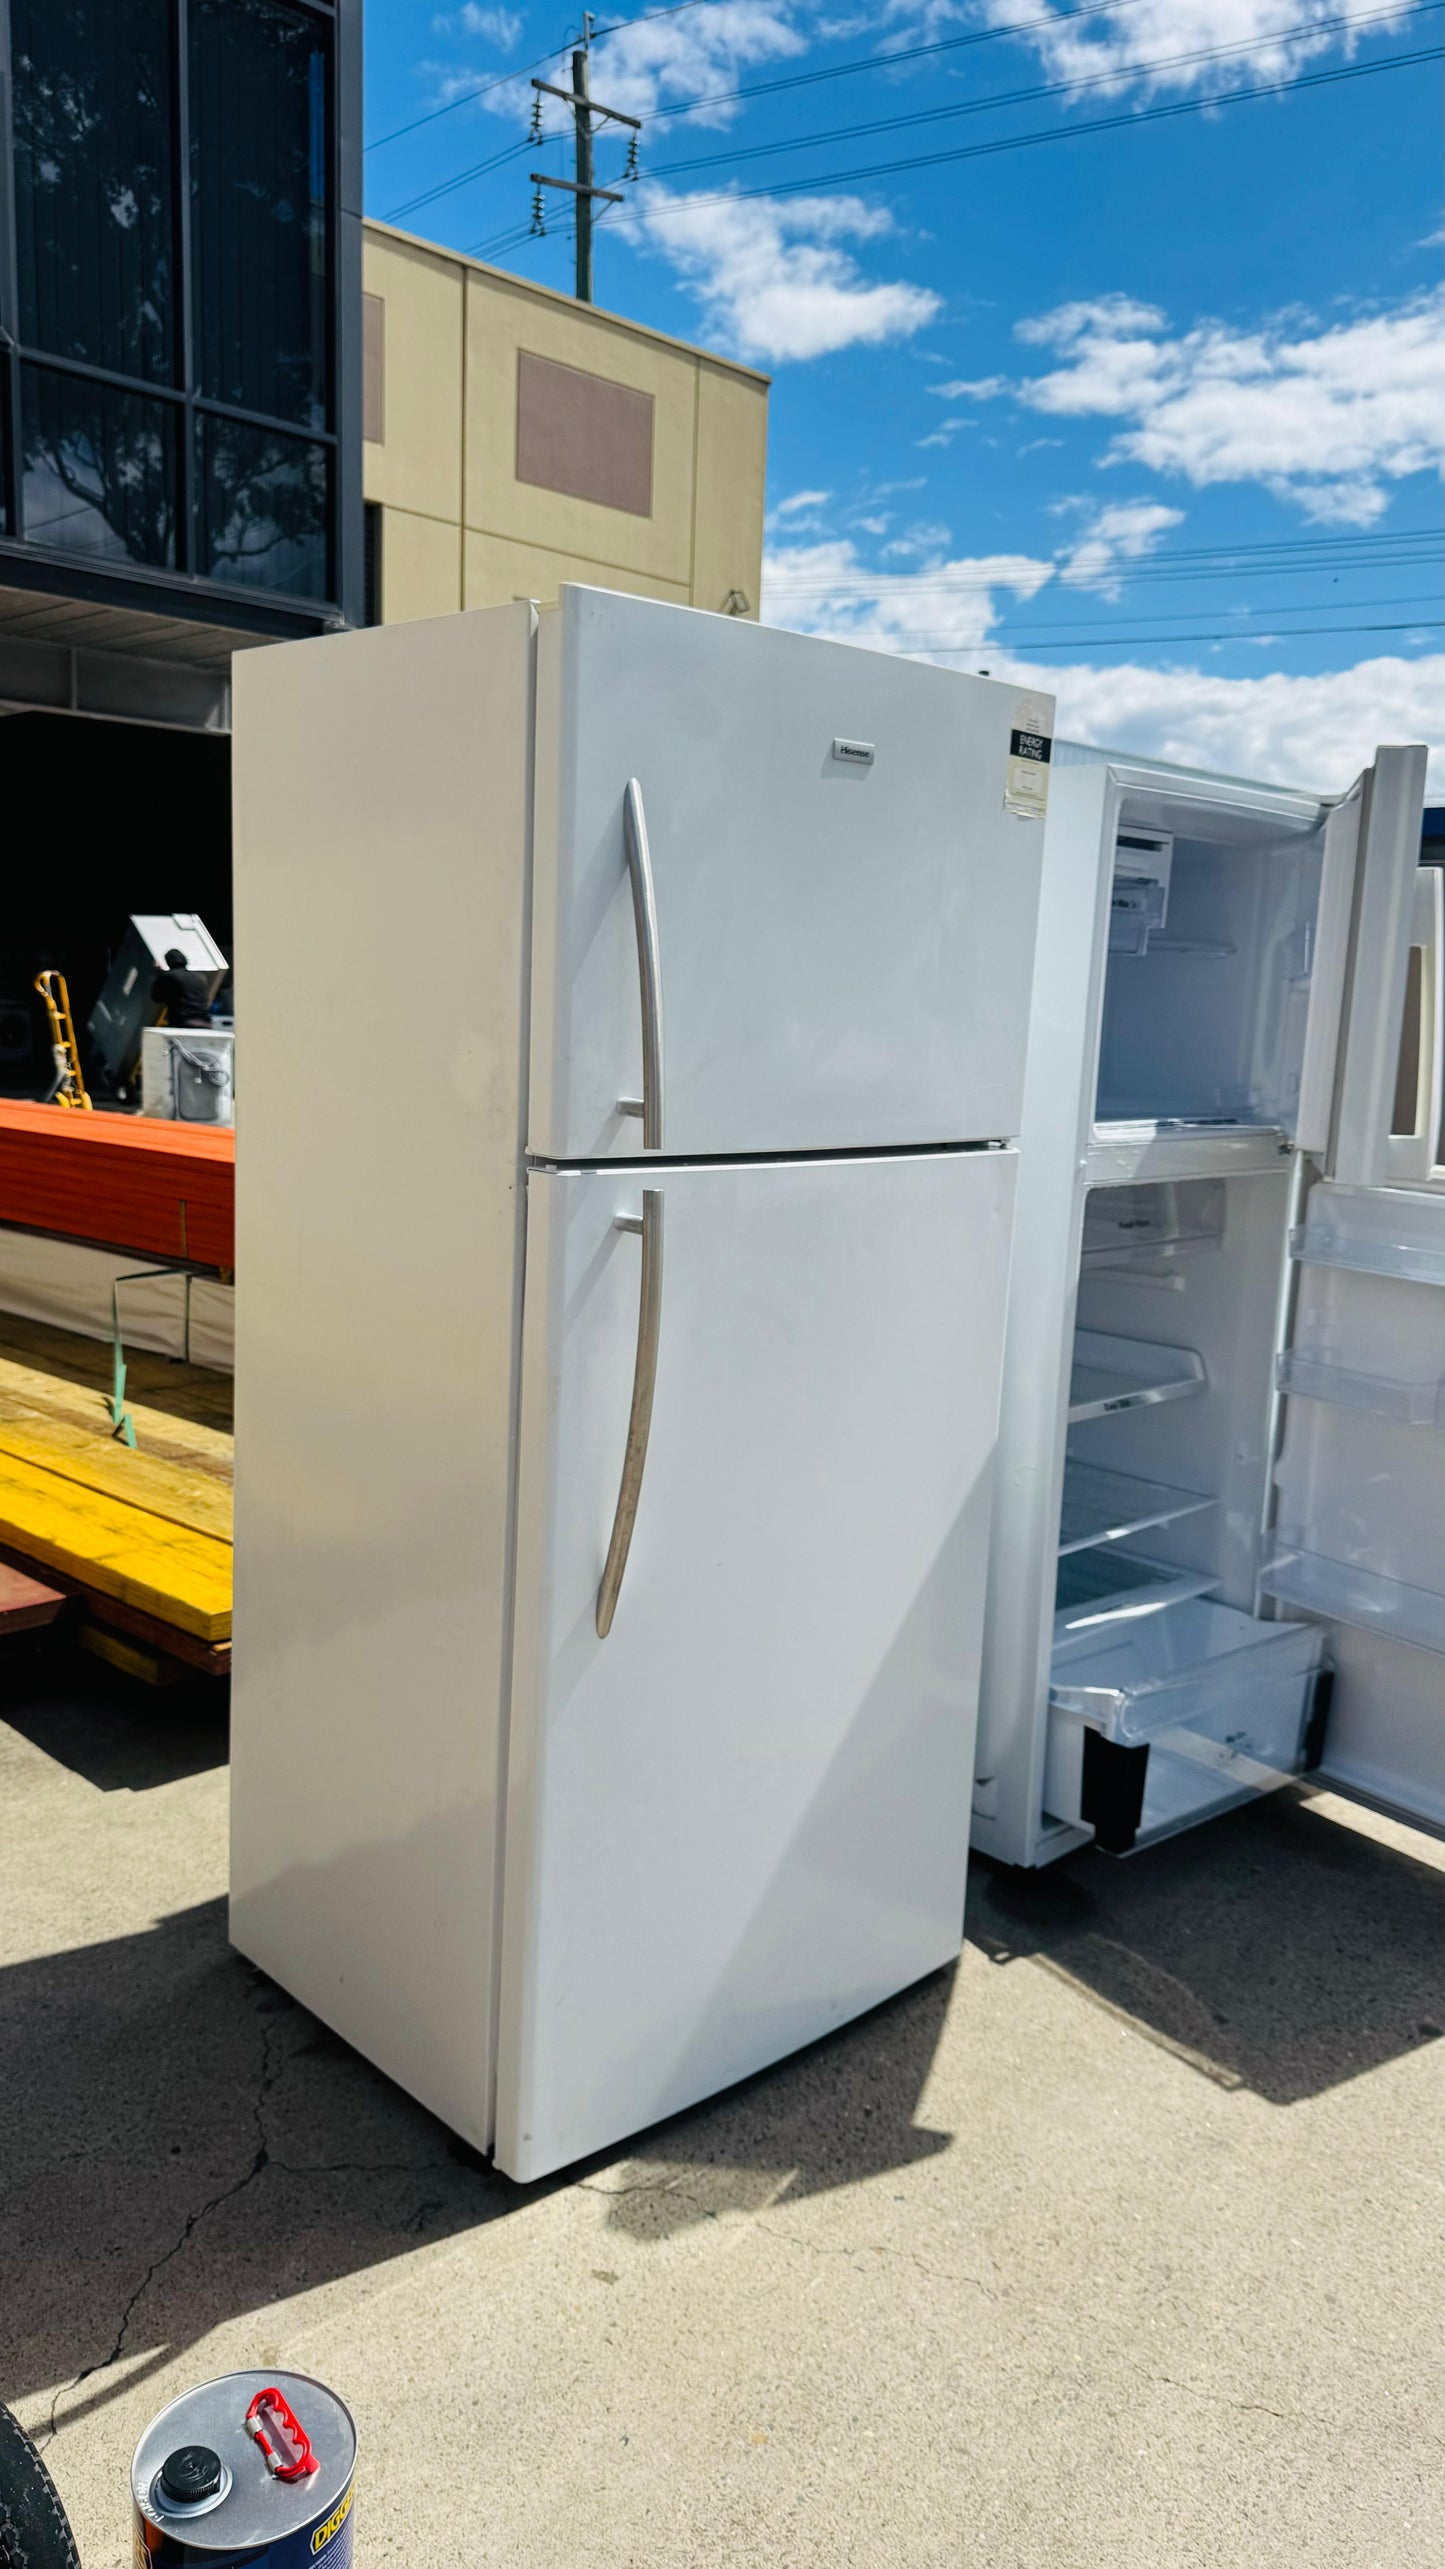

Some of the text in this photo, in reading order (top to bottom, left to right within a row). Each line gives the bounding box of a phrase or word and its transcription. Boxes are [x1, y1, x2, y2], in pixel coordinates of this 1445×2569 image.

[1020, 734, 1043, 749] ENERGY
[841, 745, 870, 759] Hisense
[1019, 747, 1043, 760] RATING
